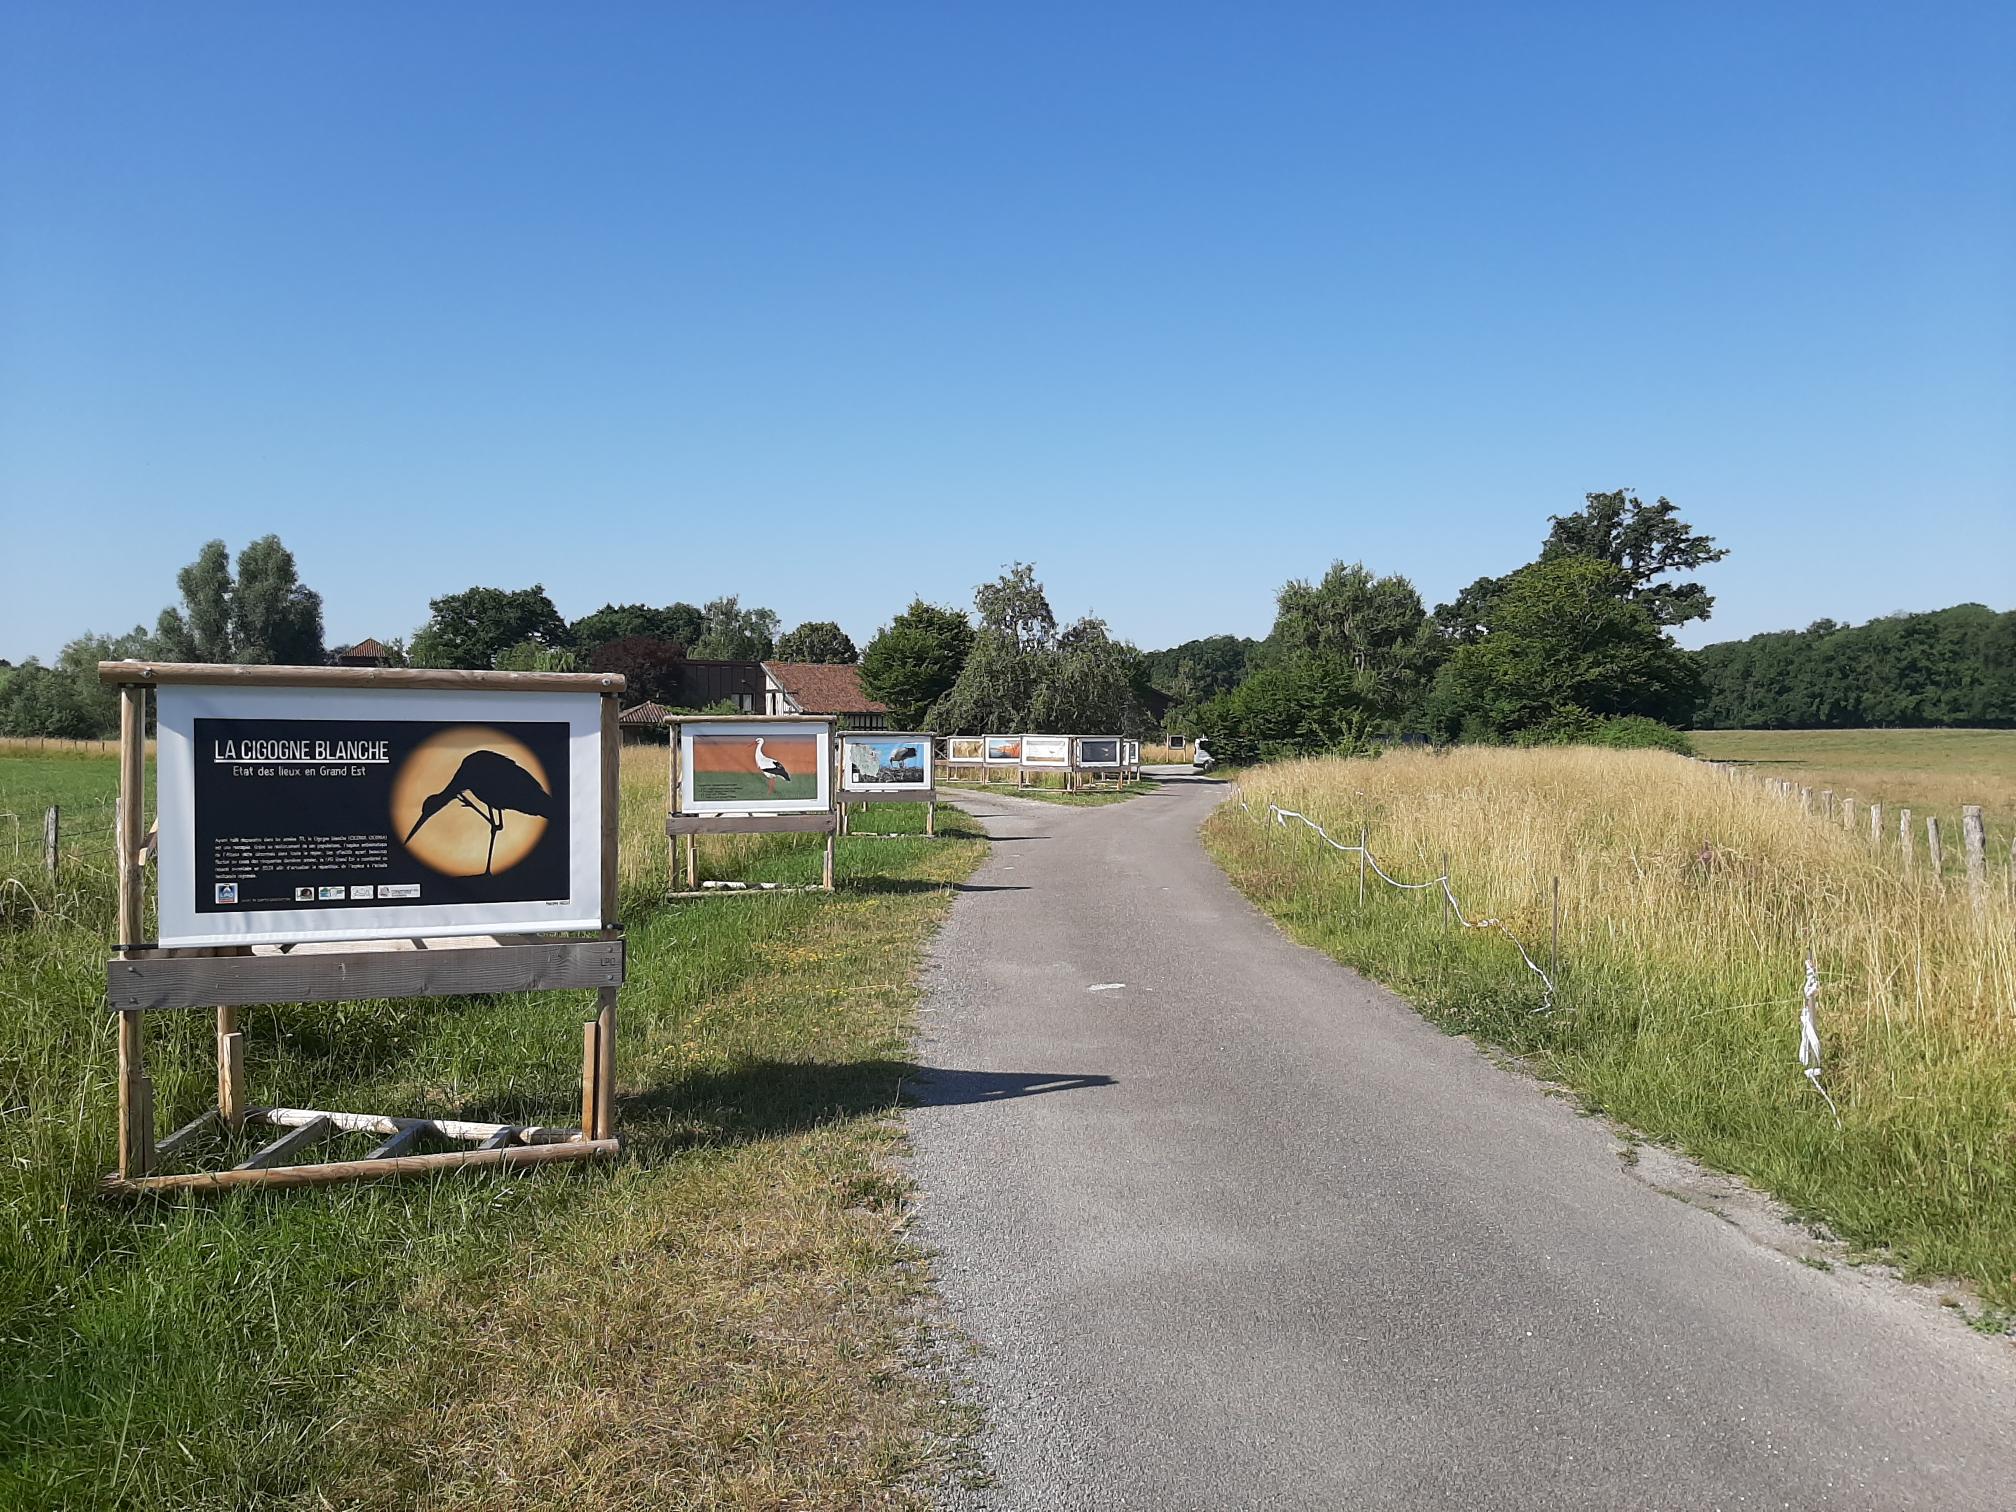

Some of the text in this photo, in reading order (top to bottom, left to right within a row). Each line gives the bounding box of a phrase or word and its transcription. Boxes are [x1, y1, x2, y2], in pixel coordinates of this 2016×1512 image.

[214, 739, 389, 760] LA CIGOGNE BLANCHE
[233, 765, 366, 777] Etat des lieux en Grand Est
